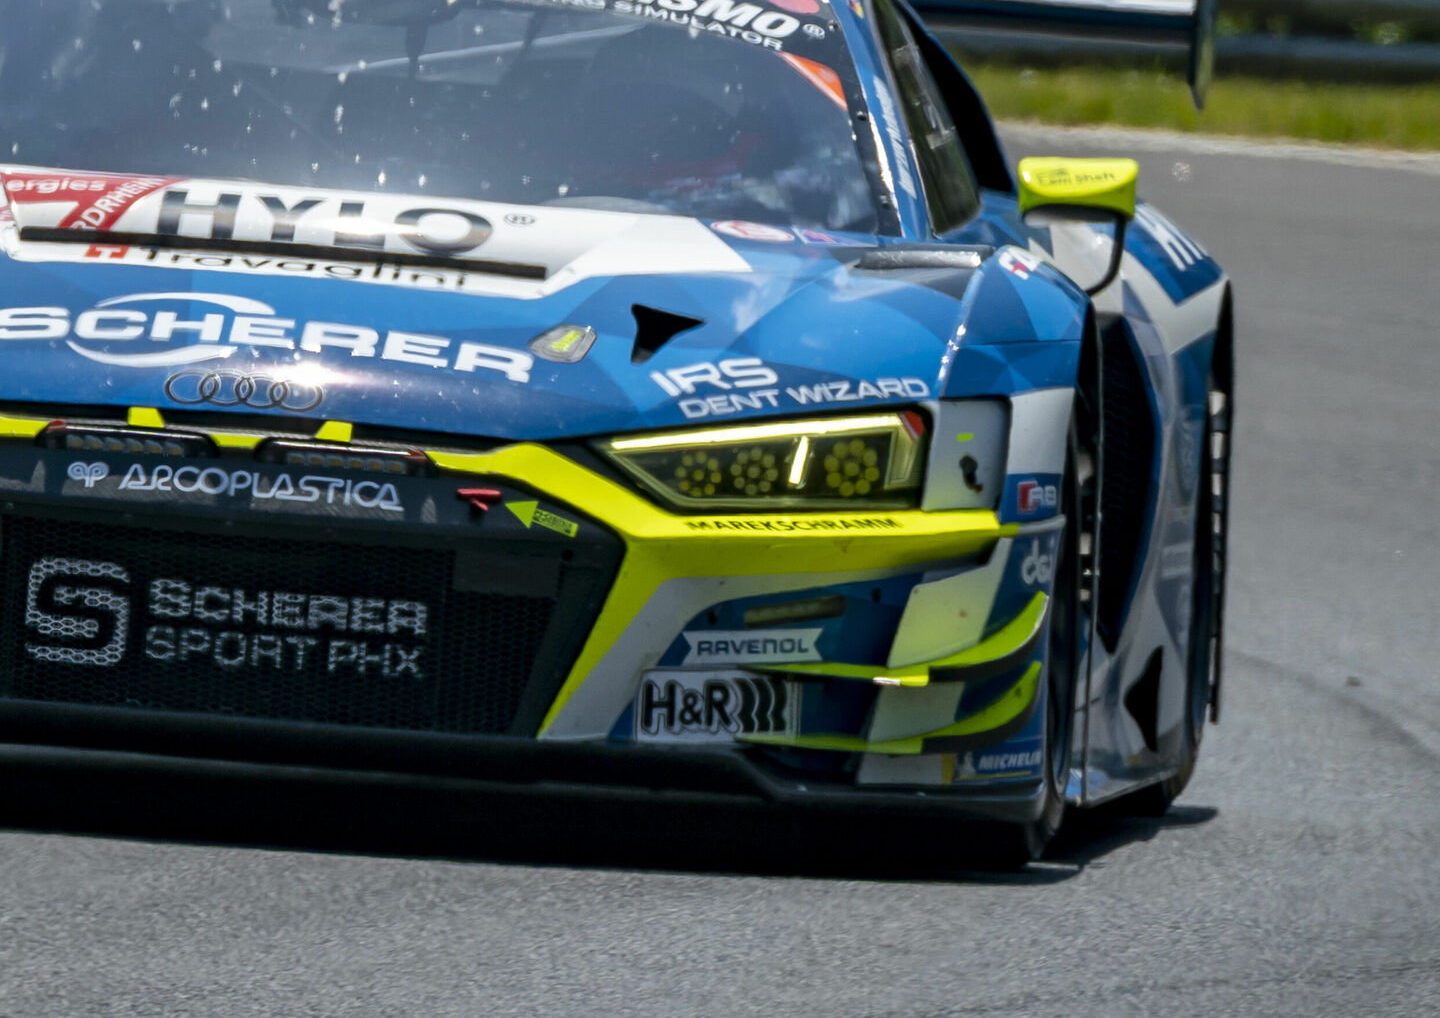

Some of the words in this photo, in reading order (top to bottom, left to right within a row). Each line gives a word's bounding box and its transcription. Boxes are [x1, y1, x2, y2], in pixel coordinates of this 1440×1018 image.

[614, 0, 784, 51] SIMULATOR
[157, 189, 495, 255] HYLO
[650, 357, 779, 397] IRS
[677, 388, 779, 419] DENT
[786, 378, 930, 405] WIZARD
[118, 463, 405, 512] ARCOPLASTICA
[686, 517, 902, 532] MAREKSCHRAMM
[148, 579, 428, 635] SCHERER
[145, 625, 318, 672] SPORT
[326, 639, 424, 679] PHX
[696, 637, 810, 656] RAVENOL
[640, 678, 738, 734] H&R
